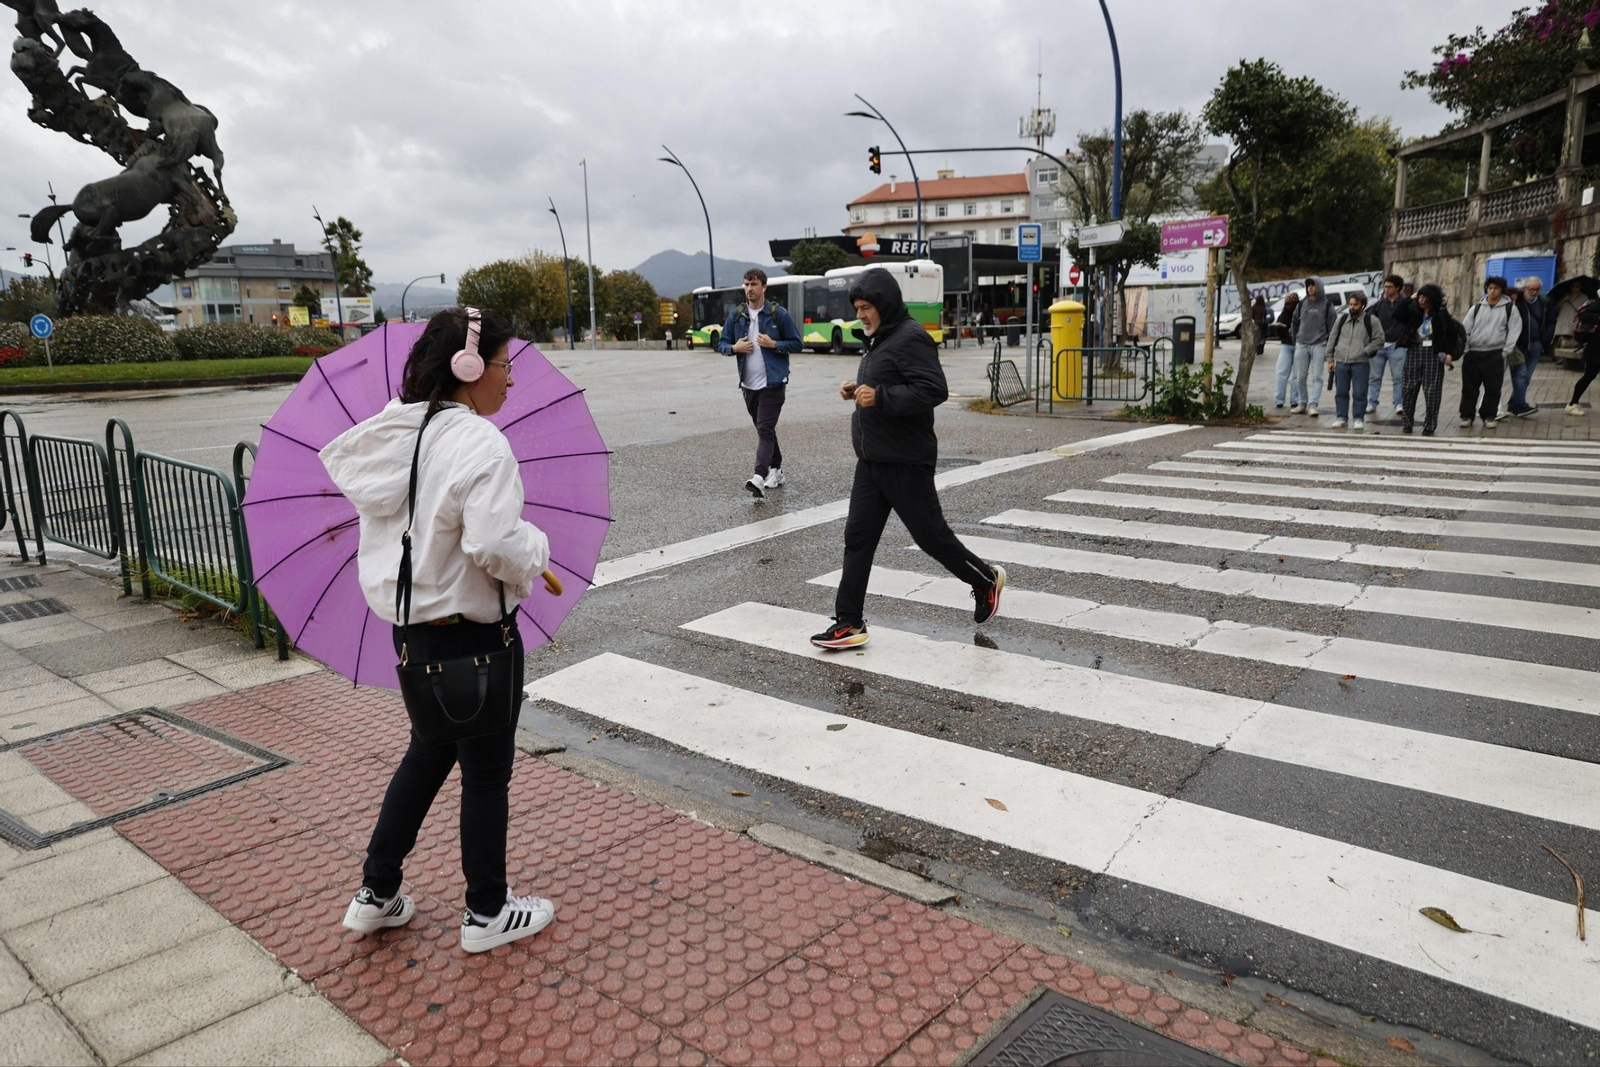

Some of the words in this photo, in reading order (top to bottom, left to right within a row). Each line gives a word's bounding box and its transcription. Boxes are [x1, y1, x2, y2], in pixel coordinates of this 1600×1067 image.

[1163, 238, 1168, 246] O
[1169, 237, 1189, 245] Castro
[1170, 265, 1194, 273] VIGO
